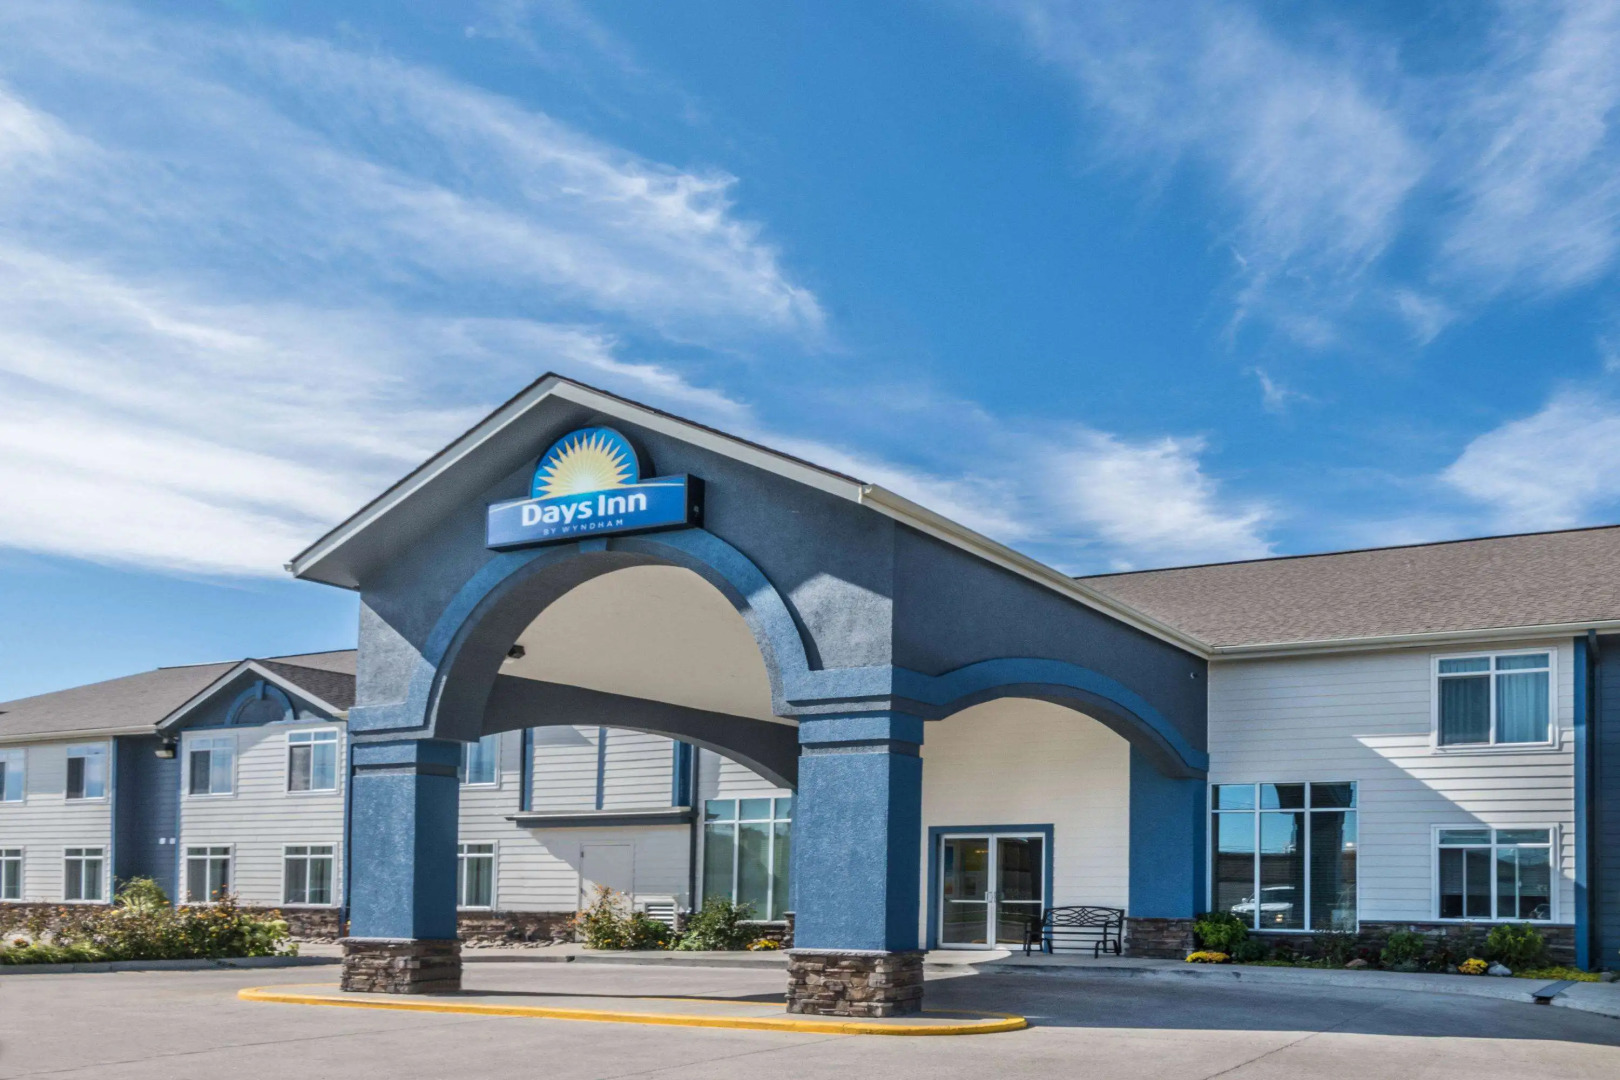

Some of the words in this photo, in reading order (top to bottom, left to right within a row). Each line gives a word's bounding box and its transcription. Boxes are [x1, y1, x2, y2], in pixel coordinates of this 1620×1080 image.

[522, 501, 593, 526] Days
[598, 493, 646, 516] Inn
[543, 527, 556, 536] BY
[562, 519, 623, 533] WYNDHAM
